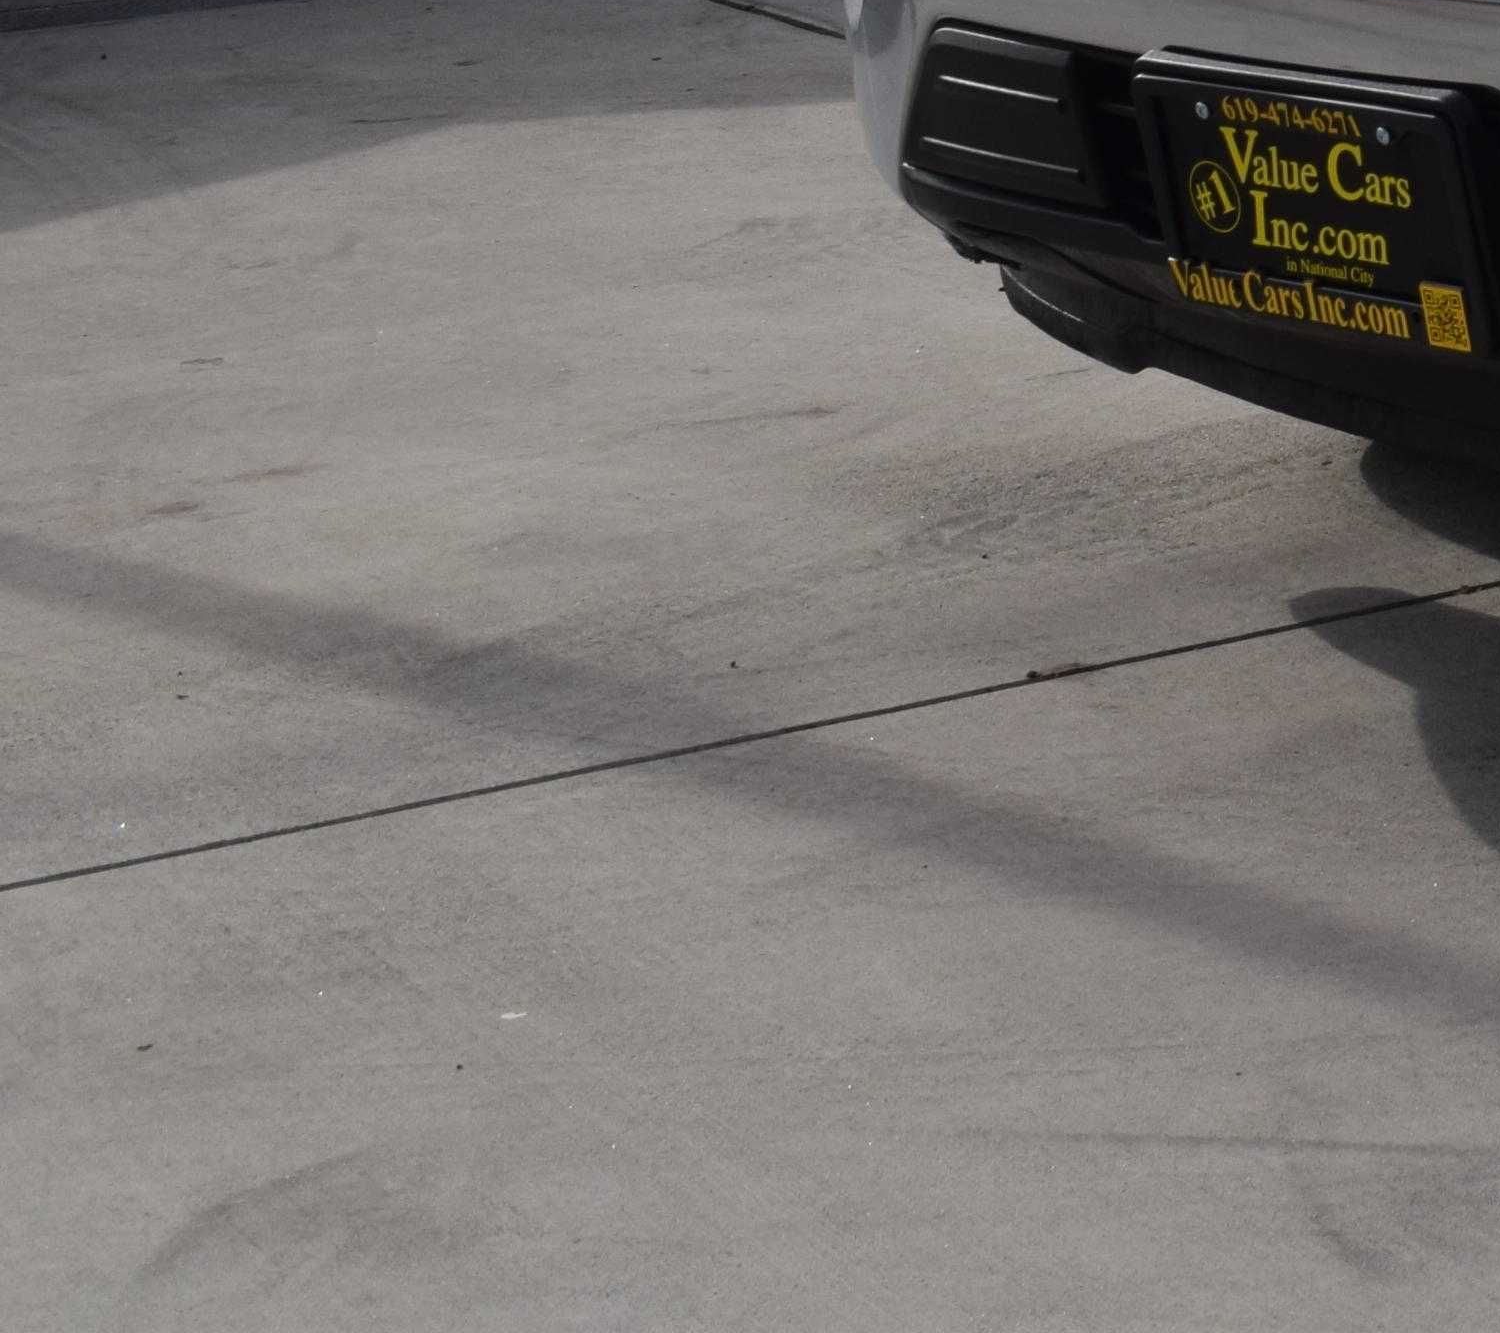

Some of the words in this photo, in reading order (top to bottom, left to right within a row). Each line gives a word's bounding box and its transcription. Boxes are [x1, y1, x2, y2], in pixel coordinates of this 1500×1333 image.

[1221, 95, 1362, 137] 619-474-6271
[1219, 126, 1320, 194] Value
[1327, 142, 1412, 209] Cars
[1196, 170, 1236, 220] #1
[1286, 258, 1299, 272] in
[1300, 259, 1348, 280] National
[1350, 267, 1376, 287] City
